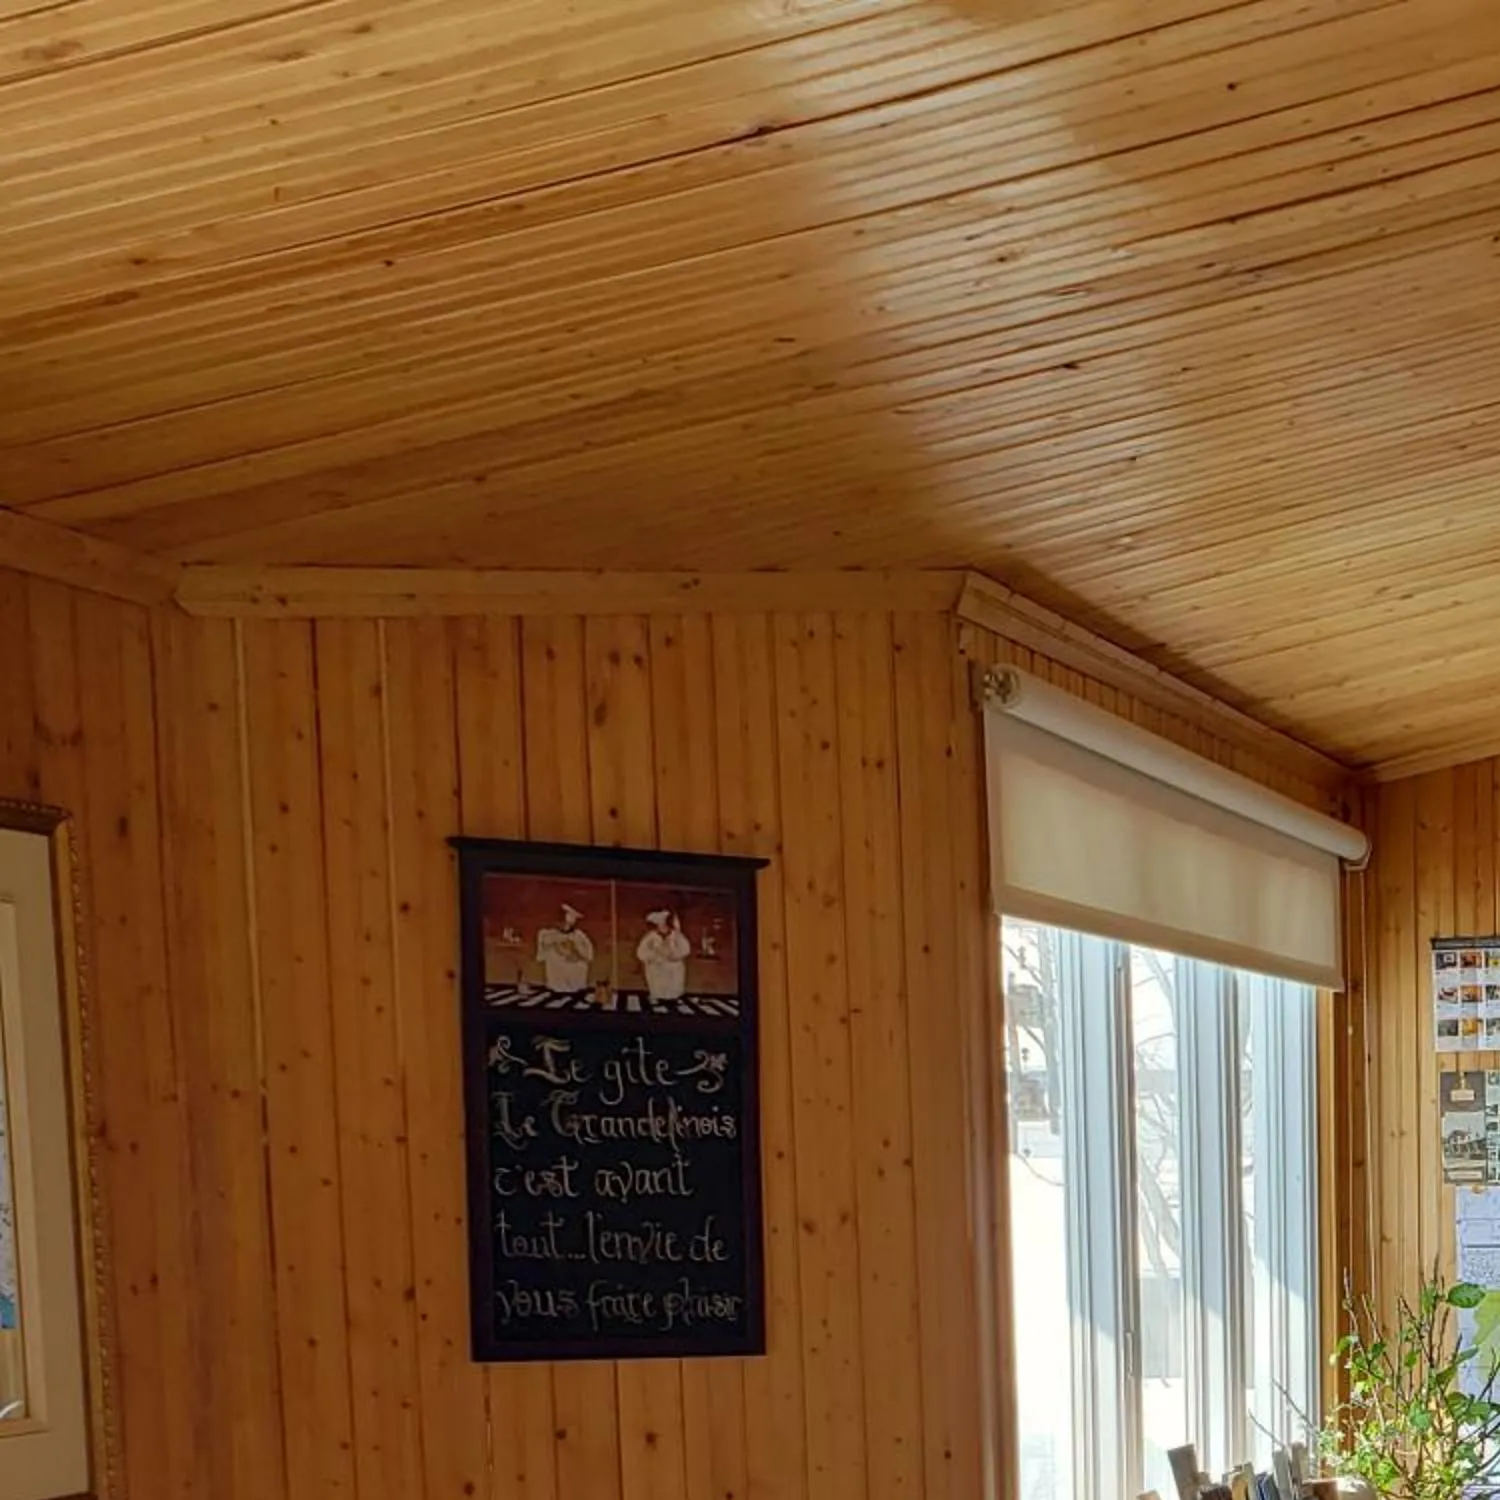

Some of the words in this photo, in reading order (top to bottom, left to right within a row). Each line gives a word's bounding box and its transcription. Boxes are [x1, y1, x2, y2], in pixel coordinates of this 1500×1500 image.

[523, 1036, 590, 1085] Le
[594, 1154, 695, 1204] avant
[690, 1215, 731, 1263] de
[587, 1279, 655, 1332] faire
[659, 1277, 743, 1332] plaisir
